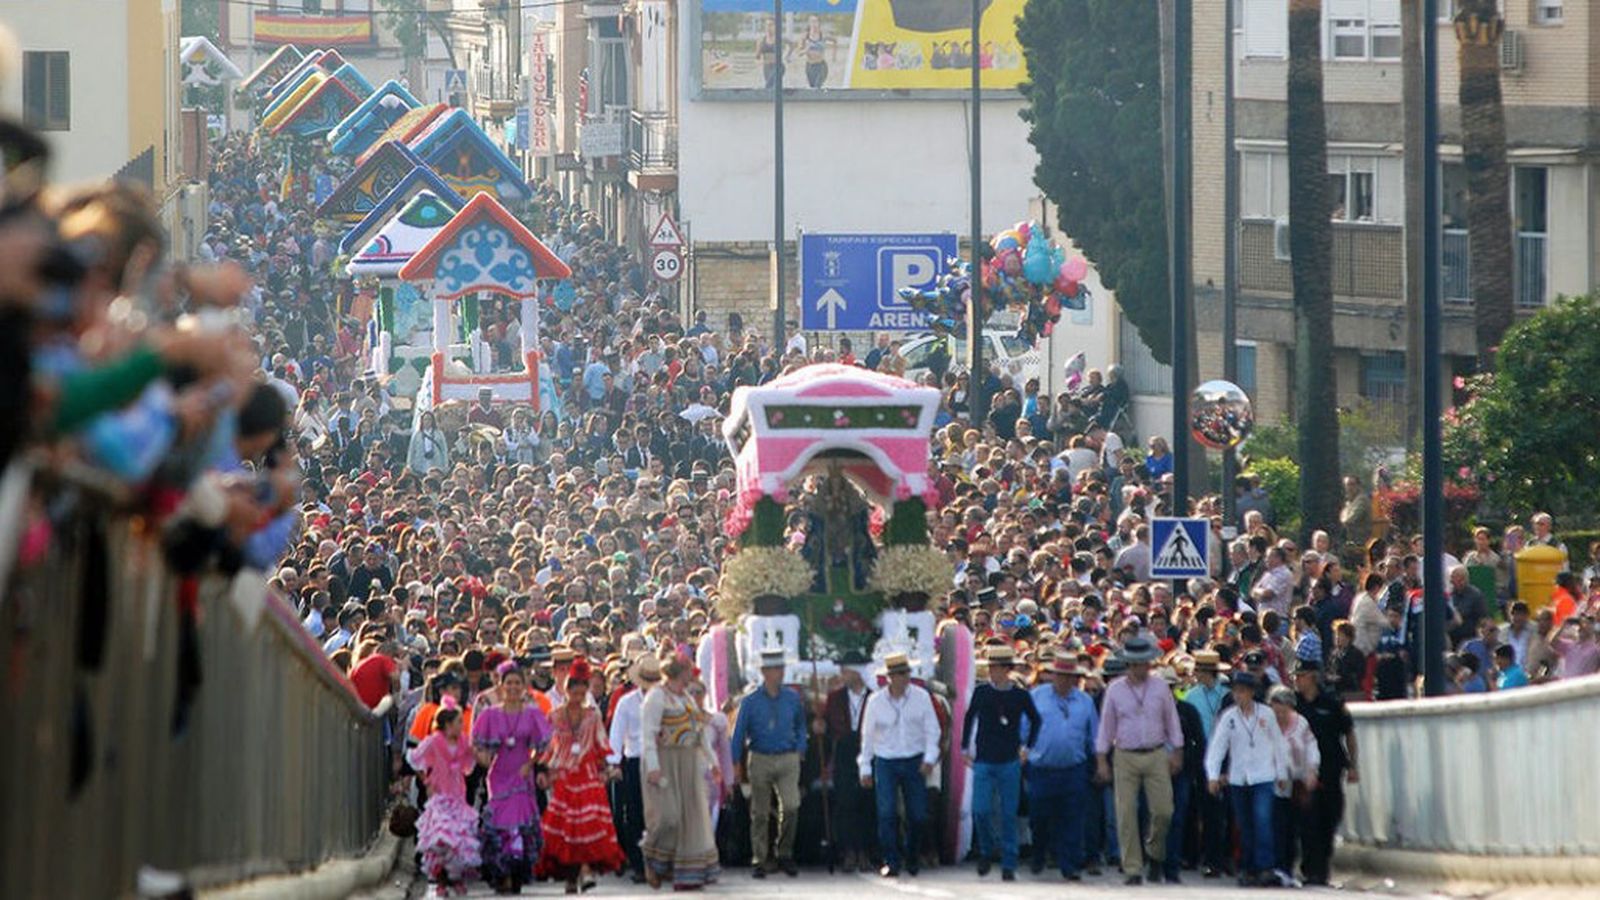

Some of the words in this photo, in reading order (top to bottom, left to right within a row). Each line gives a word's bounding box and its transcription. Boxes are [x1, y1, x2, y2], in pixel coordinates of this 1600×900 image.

[826, 236, 868, 244] TARIFAS
[870, 236, 932, 244] ESPECIALES
[656, 259, 677, 271] 30
[893, 254, 934, 304] P
